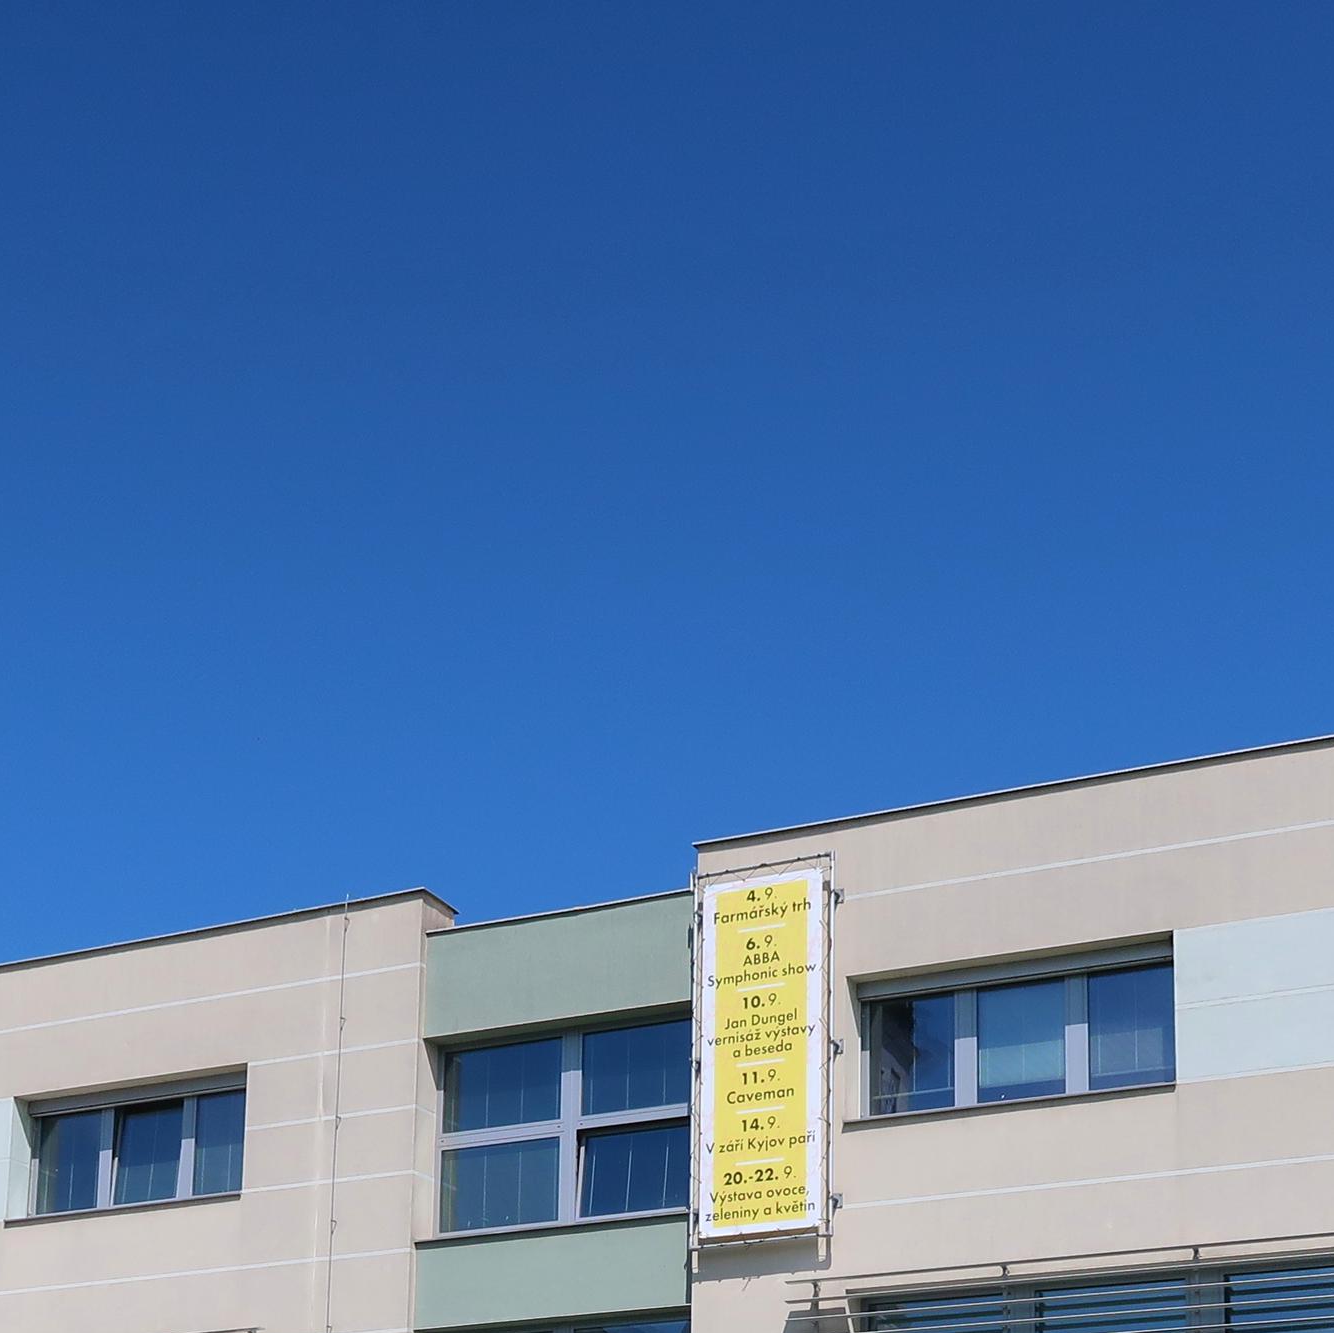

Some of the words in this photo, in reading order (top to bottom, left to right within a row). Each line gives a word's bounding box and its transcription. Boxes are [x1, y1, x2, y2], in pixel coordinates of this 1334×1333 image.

[746, 890, 761, 902] 4.
[764, 887, 777, 900] 9.
[713, 901, 788, 925] Farmářský
[792, 897, 811, 912] trh
[746, 938, 760, 951] 6.
[764, 934, 777, 948] 9.
[743, 951, 780, 966] ABBA
[707, 966, 778, 989] Symphonic
[782, 963, 816, 977] show
[743, 995, 765, 1009] 10.
[768, 993, 781, 1006] 9.
[725, 1018, 747, 1030] Jan
[751, 1008, 798, 1026] Dungel
[707, 1028, 761, 1046] vernisáž
[765, 1024, 815, 1041] výstavy
[733, 1050, 741, 1058] a
[745, 1040, 792, 1057] beseda
[742, 1071, 765, 1085] 11.
[768, 1069, 781, 1082] 9.
[726, 1087, 794, 1104] Caveman
[742, 1118, 764, 1132] 14.
[767, 1116, 781, 1129] 9.
[706, 1143, 715, 1154] V
[719, 1140, 744, 1153] září
[747, 1136, 785, 1152] Kyjov
[789, 1130, 816, 1148] paří
[723, 1168, 779, 1186] 20.-22.
[784, 1165, 797, 1179] 9.
[710, 1190, 762, 1207] Výstava
[767, 1185, 810, 1199] ovoce,
[705, 1206, 759, 1222] zeleniny
[763, 1207, 771, 1216] a
[776, 1200, 816, 1214] květin
